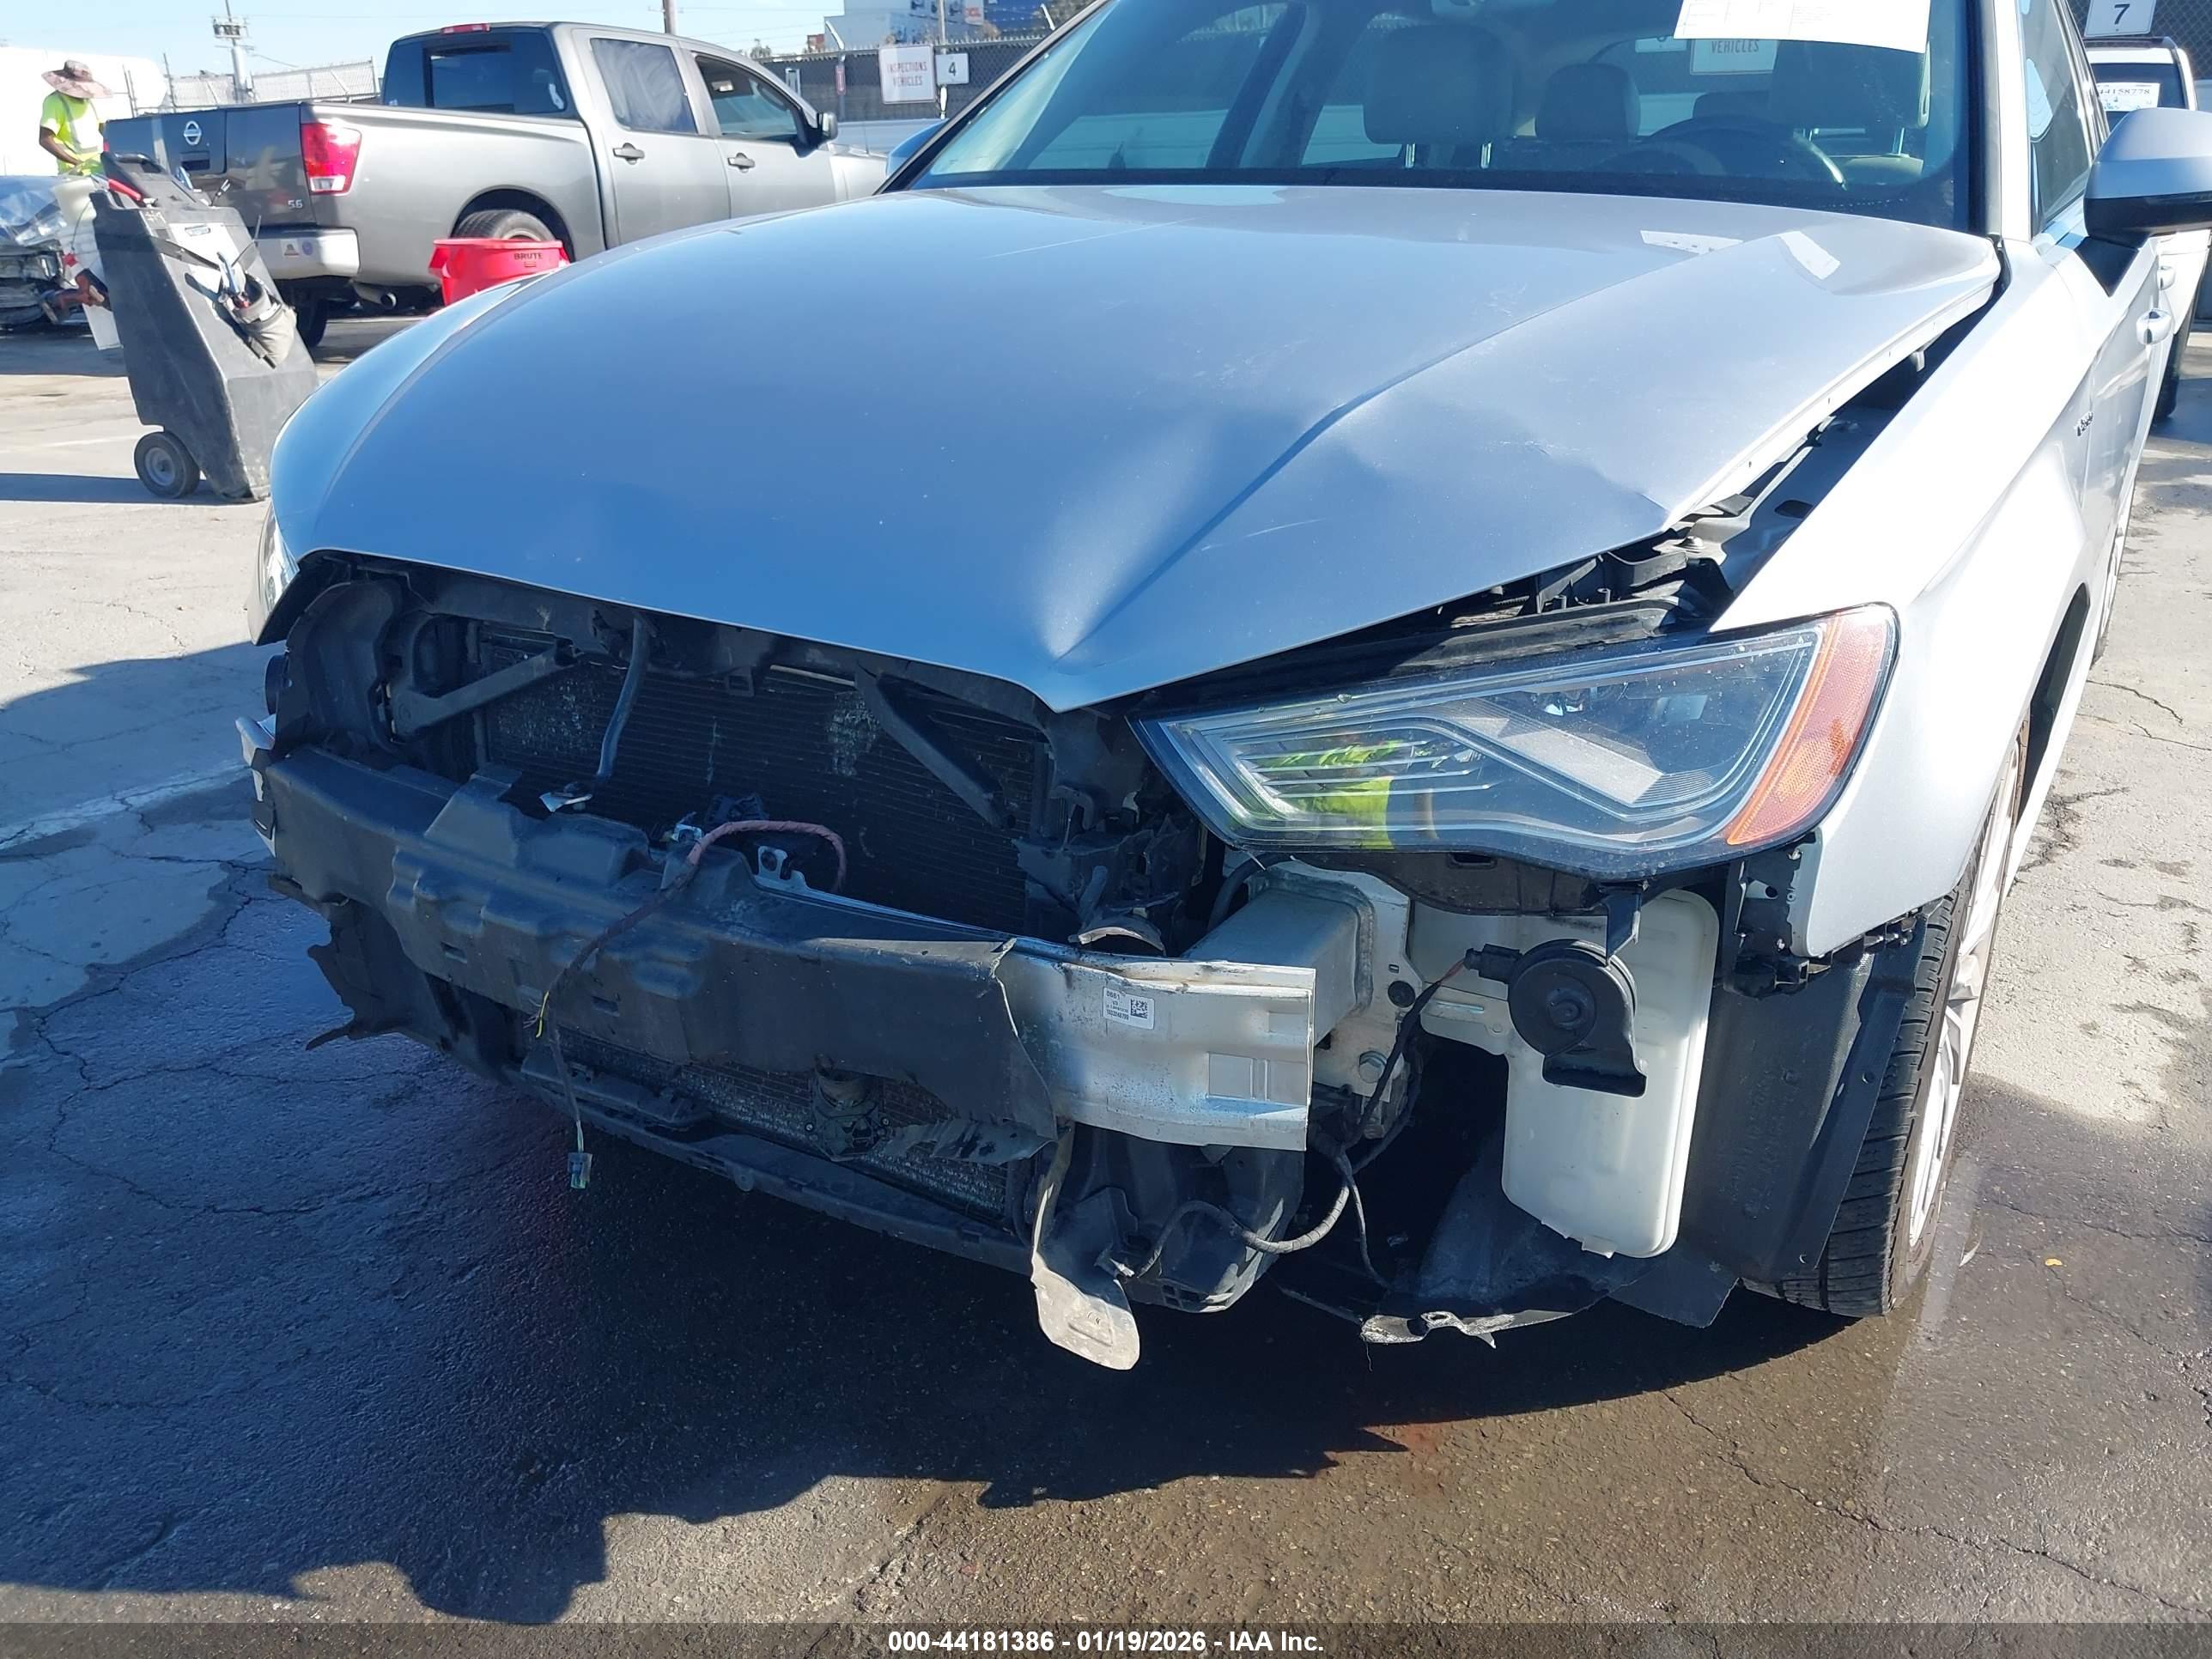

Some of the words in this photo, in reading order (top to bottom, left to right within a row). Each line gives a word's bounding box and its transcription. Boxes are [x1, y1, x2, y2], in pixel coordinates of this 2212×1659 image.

[2114, 3, 2130, 25] 7
[1711, 40, 1759, 53] VEHICLES
[948, 62, 957, 76] 4
